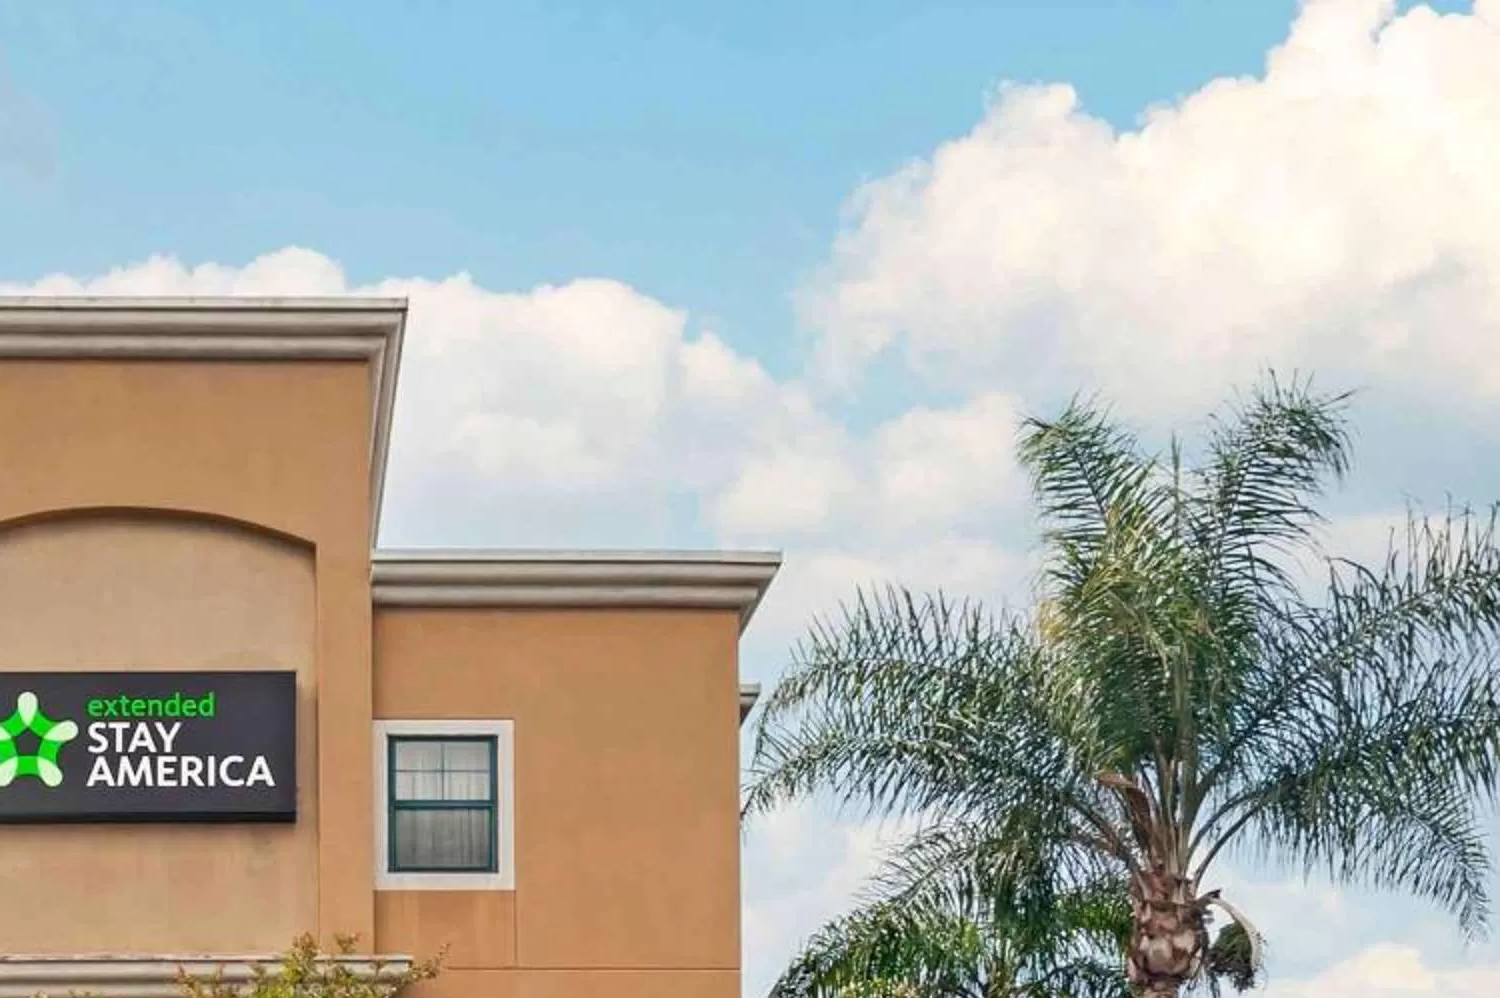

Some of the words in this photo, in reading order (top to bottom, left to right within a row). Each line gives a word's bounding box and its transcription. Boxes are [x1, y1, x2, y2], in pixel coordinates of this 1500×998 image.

[87, 692, 215, 717] extended
[87, 721, 182, 753] STAY
[86, 756, 276, 787] AMERICA
